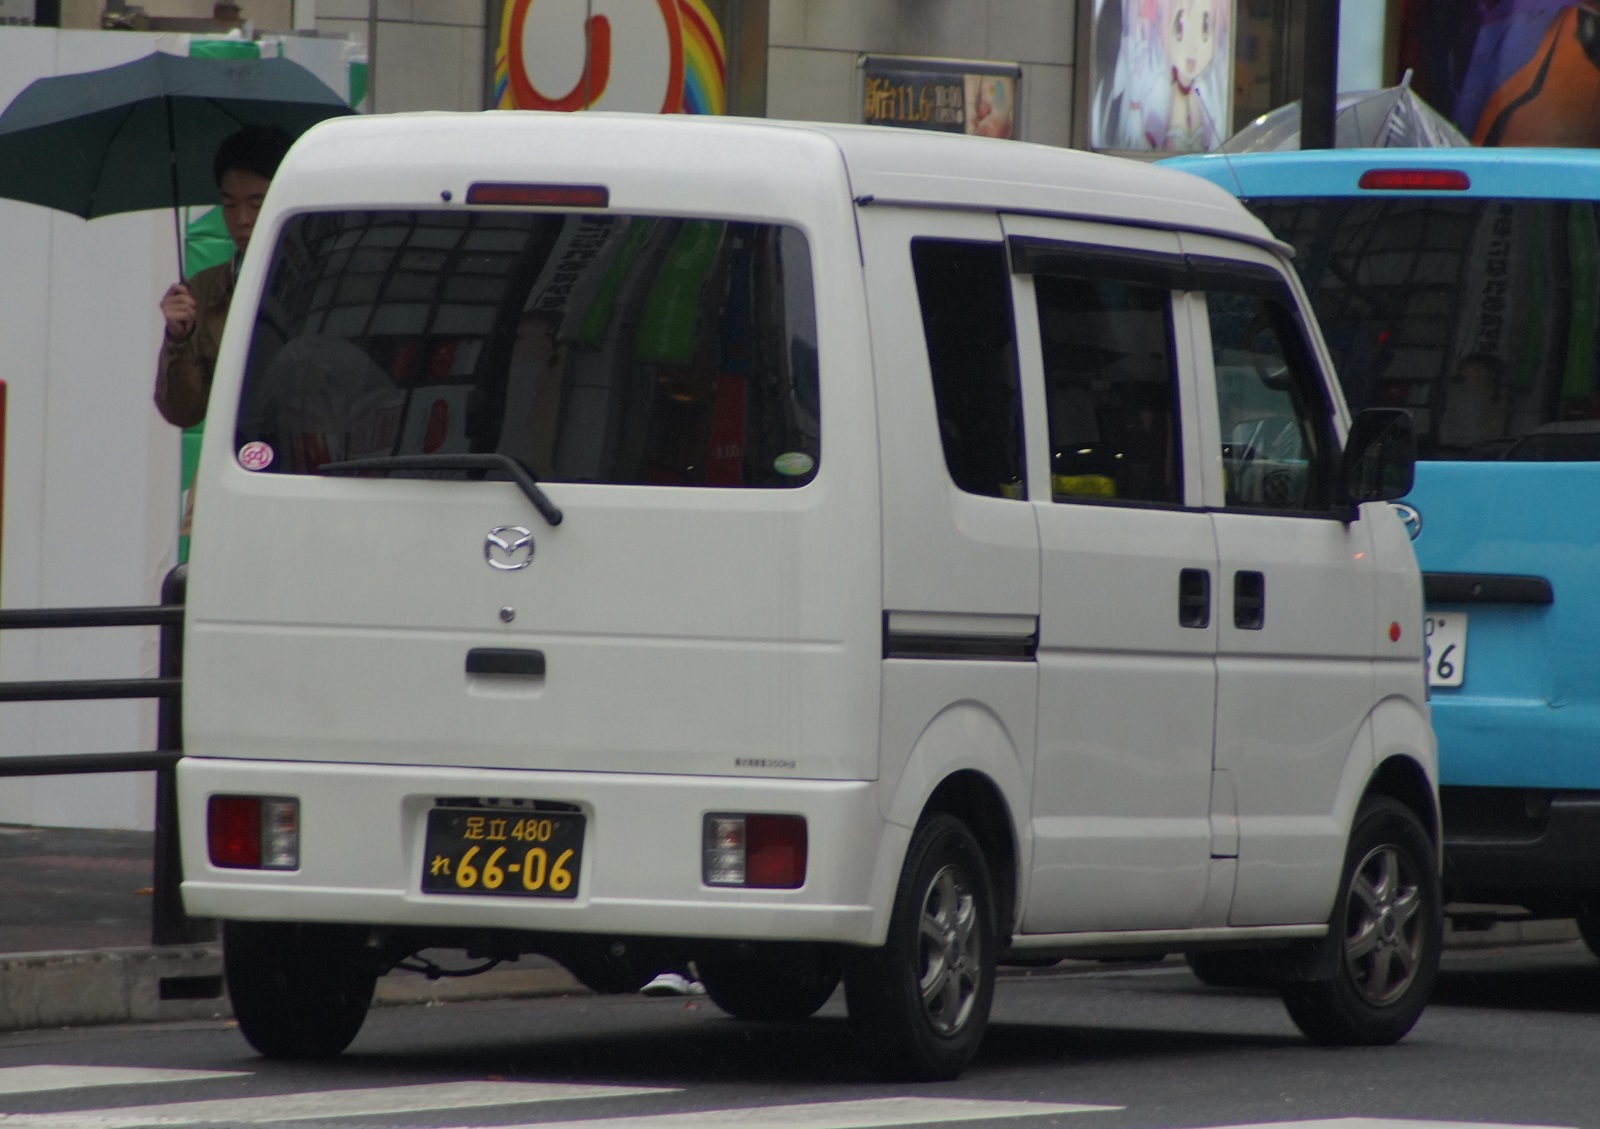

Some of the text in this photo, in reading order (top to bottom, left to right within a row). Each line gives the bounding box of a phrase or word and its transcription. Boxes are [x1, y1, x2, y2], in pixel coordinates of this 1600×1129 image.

[463, 816, 551, 842] 足立 480
[430, 845, 574, 891] れ 66-06
